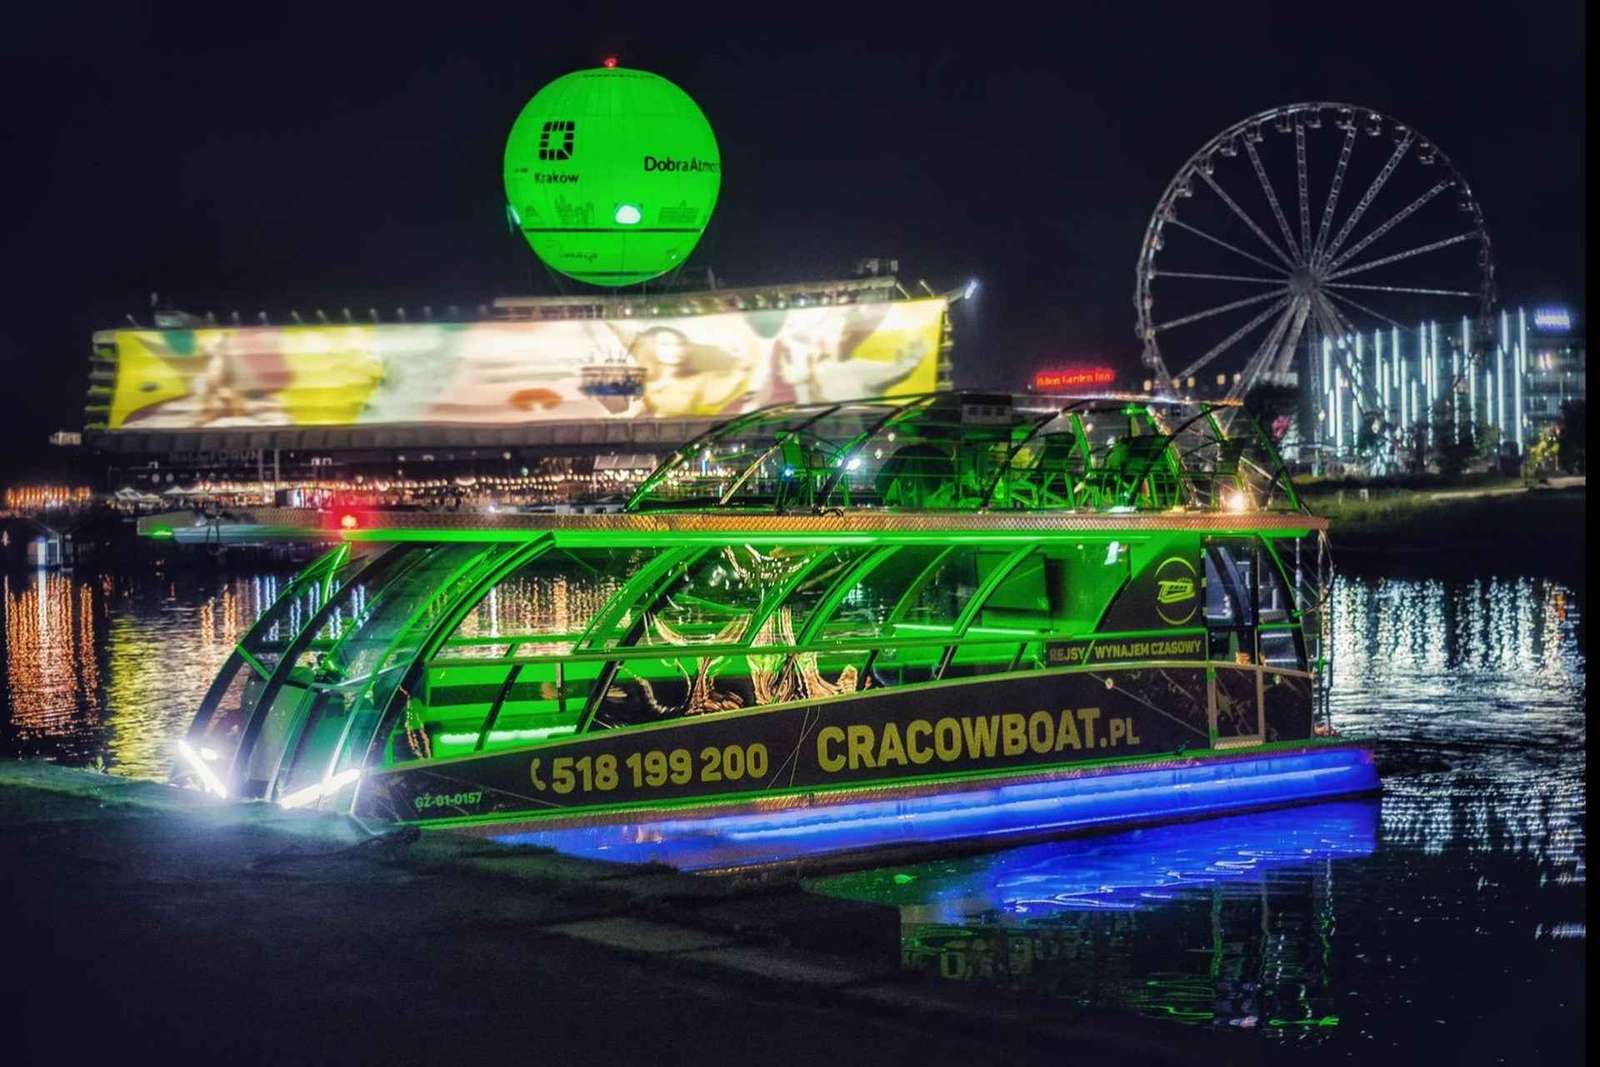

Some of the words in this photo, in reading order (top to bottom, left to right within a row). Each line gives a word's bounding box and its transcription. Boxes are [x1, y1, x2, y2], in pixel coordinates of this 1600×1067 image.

[643, 156, 688, 172] Dobra
[1049, 647, 1085, 661] REJSY
[1095, 642, 1150, 659] WYNAJEM
[1151, 639, 1201, 656] CZASOWY
[817, 707, 1140, 772] CRACOWBOAT.PL
[551, 754, 619, 795] 518
[626, 748, 693, 788] 199
[699, 743, 769, 782] 200
